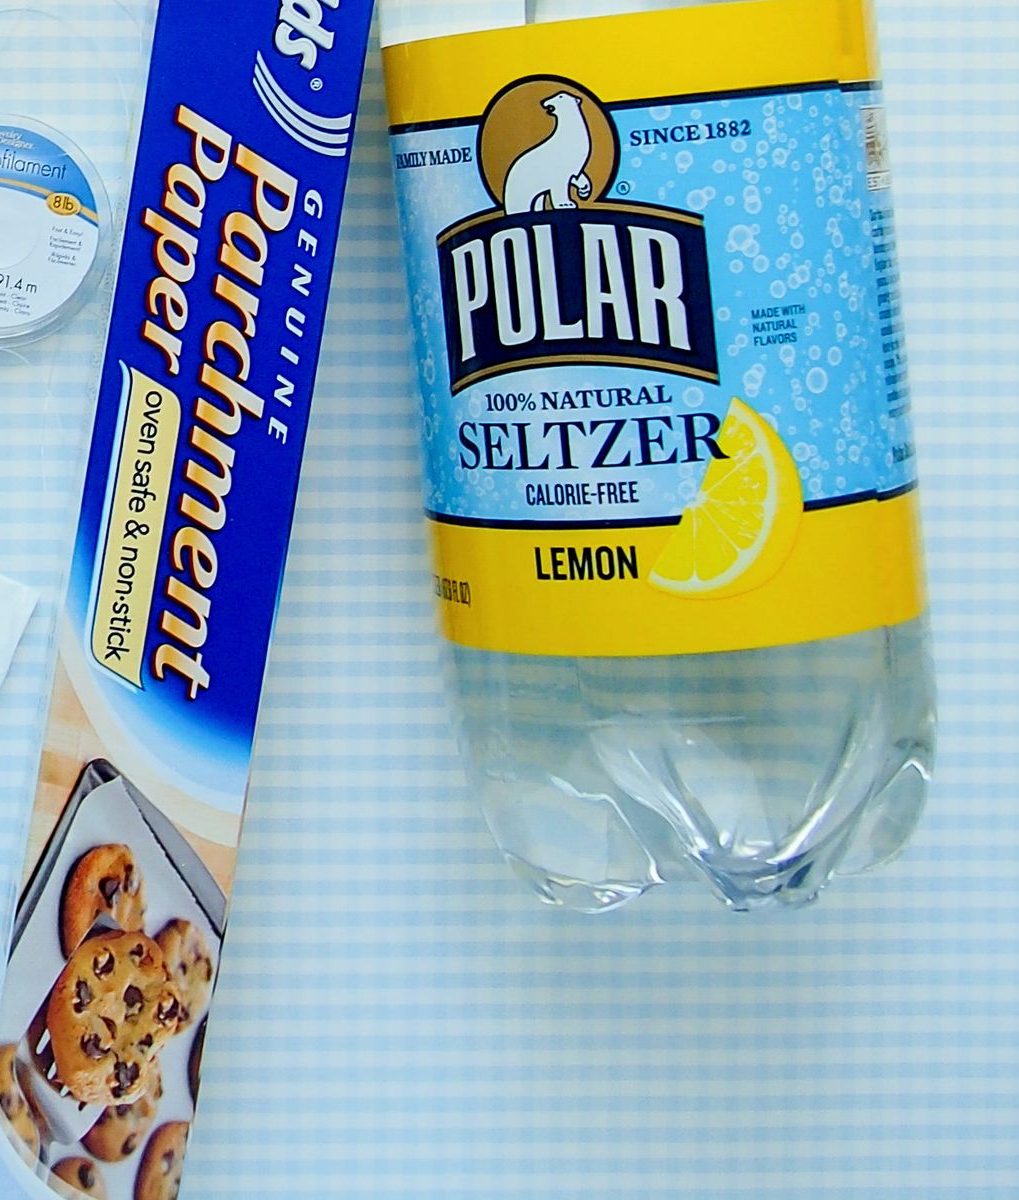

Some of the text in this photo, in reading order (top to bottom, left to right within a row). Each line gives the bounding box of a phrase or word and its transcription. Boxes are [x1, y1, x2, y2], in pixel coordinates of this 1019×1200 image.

[629, 119, 752, 146] SINCE 1882
[429, 147, 472, 166] MADE
[53, 195, 74, 211] 8 lb
[140, 103, 233, 378] Paper
[26, 283, 38, 294] m
[451, 222, 692, 362] POLAR
[268, 189, 323, 444] GENUINE
[751, 304, 805, 319] MADE WITH
[752, 318, 798, 333] NATURAL
[754, 332, 797, 346] FLAVORS
[485, 384, 673, 412] 100% NATURAL
[137, 390, 163, 455] oven
[151, 142, 298, 701] Parchment
[457, 412, 731, 471] SELTZER
[129, 459, 156, 513] safe
[525, 481, 640, 506] CALORIE-FREE
[123, 519, 150, 540] &
[534, 545, 639, 580] LEMON
